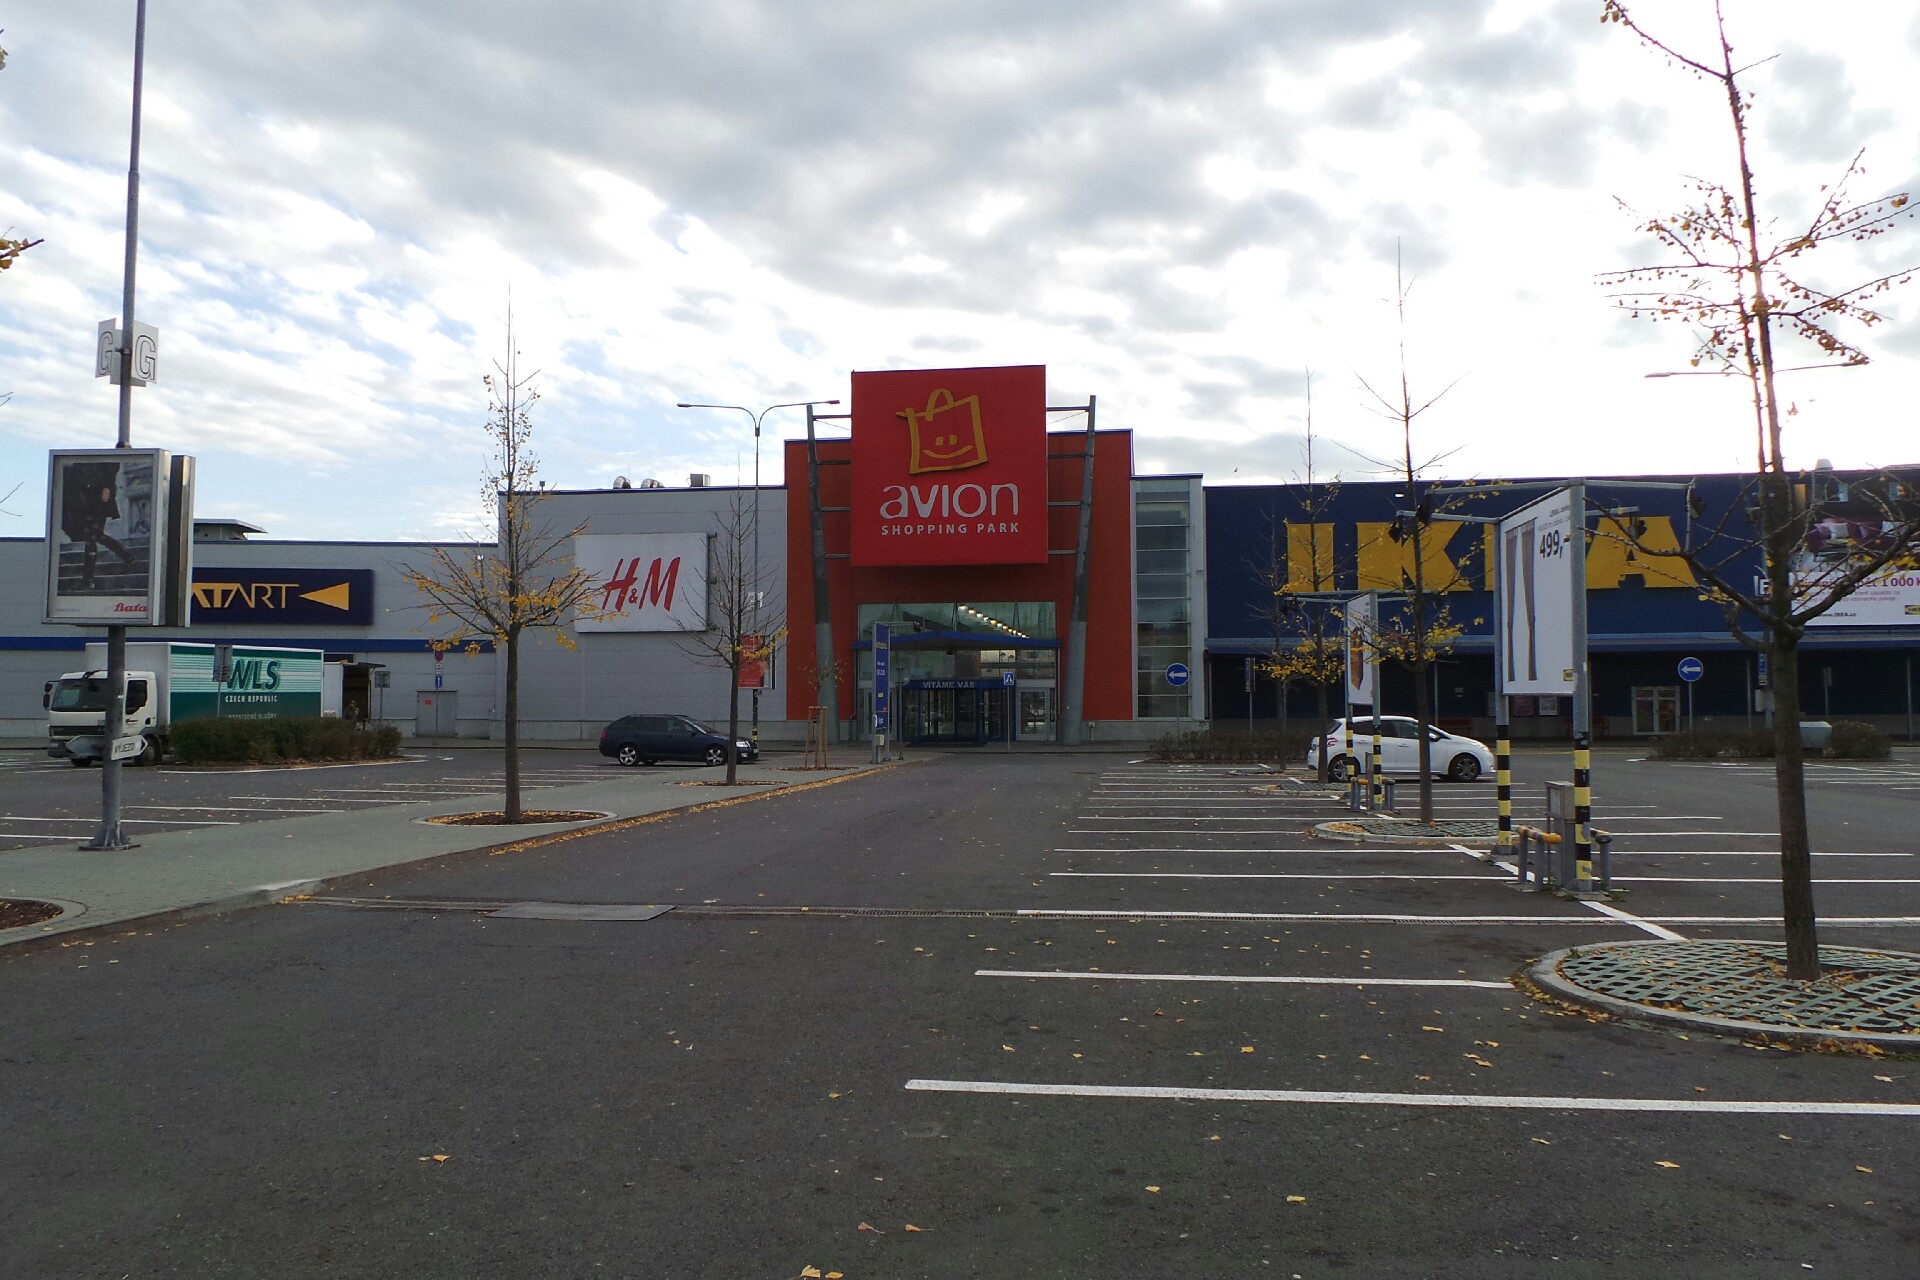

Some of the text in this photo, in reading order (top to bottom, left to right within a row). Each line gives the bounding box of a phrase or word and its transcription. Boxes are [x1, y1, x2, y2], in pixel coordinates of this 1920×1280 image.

[99, 331, 113, 375] G
[135, 335, 156, 380] G
[880, 483, 1018, 519] avion
[881, 522, 1019, 536] SHOPPING PARK
[1287, 516, 1699, 592] IKA
[602, 557, 681, 612] H&M
[227, 660, 279, 690] WLS
